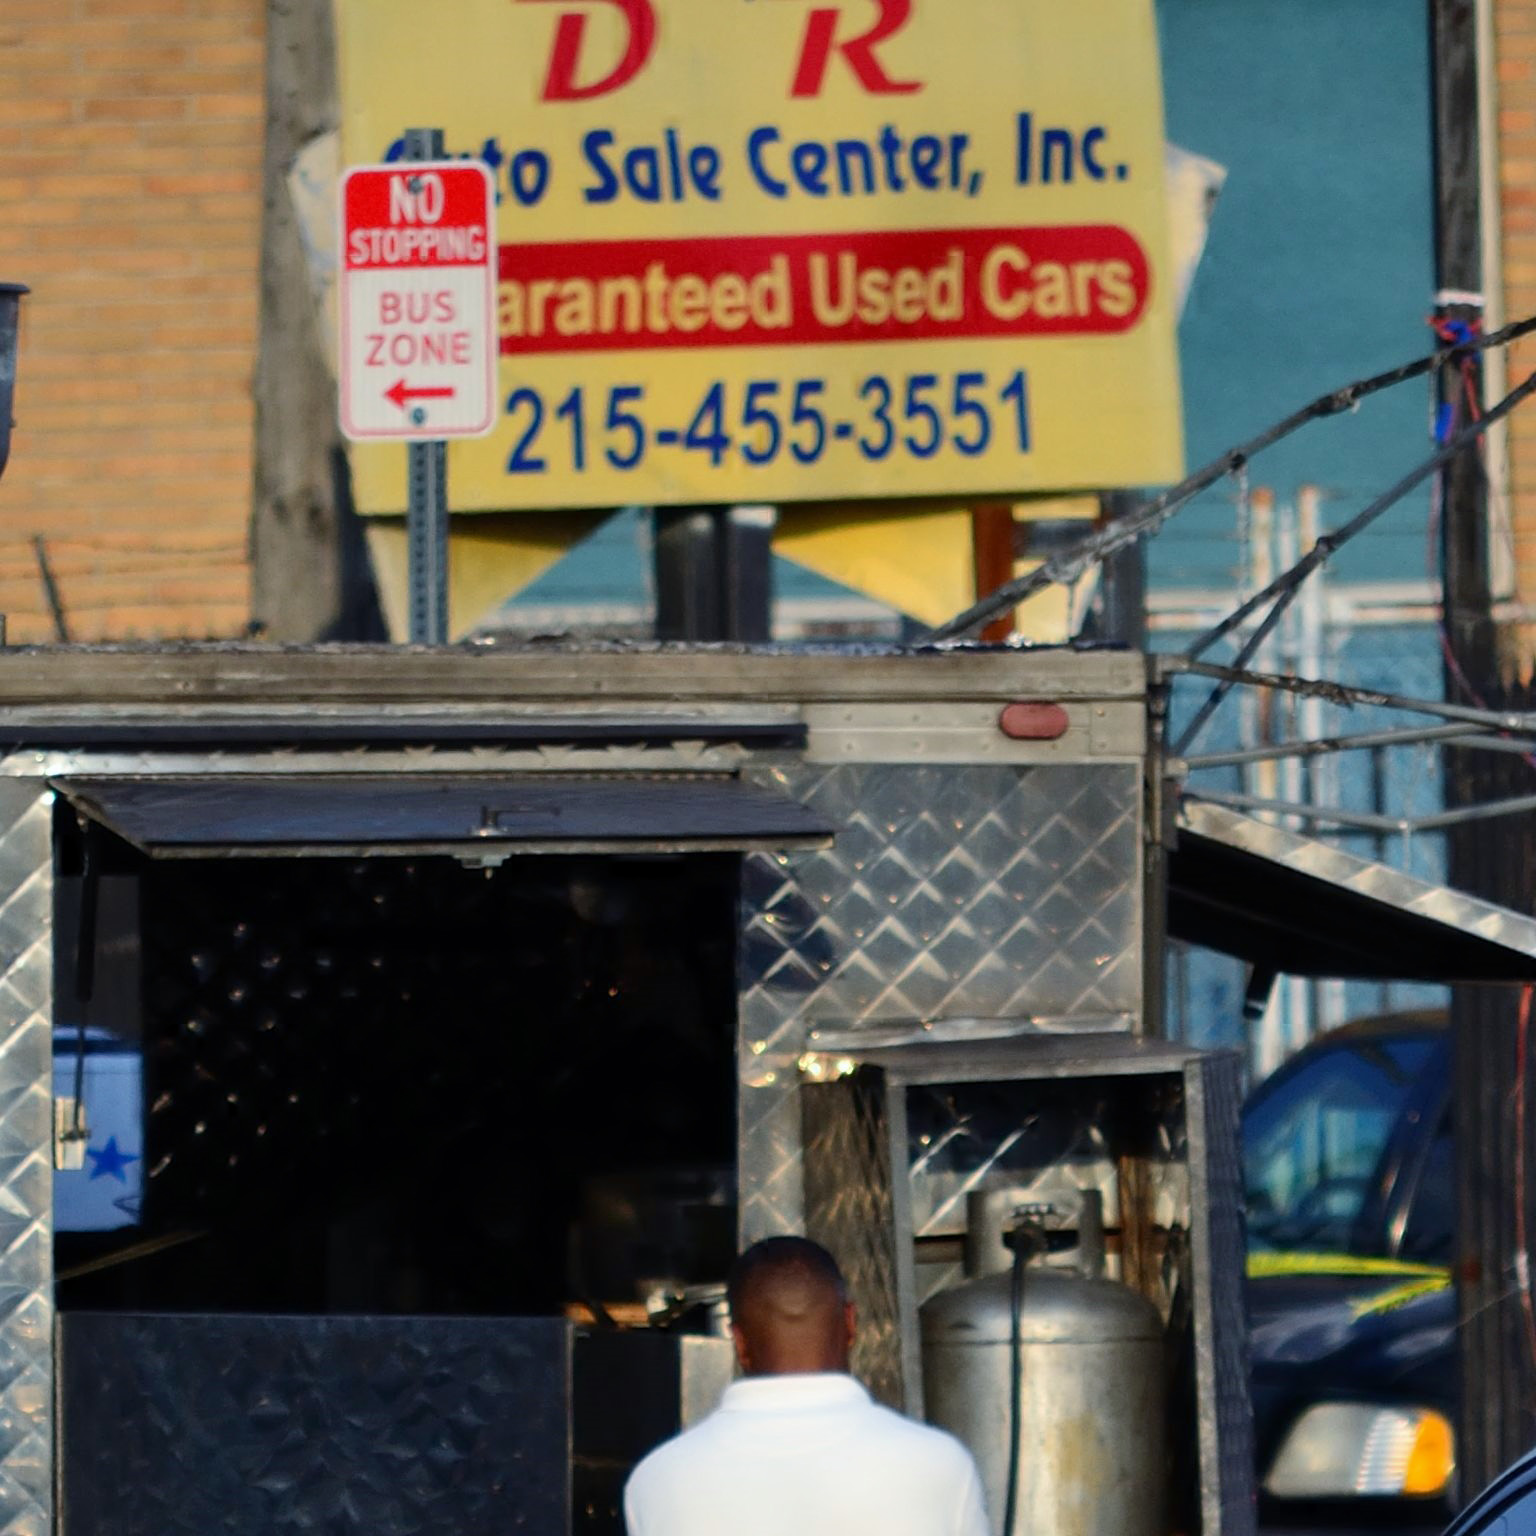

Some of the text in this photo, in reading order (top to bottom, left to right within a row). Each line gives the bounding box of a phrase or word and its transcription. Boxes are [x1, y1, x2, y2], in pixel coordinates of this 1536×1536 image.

[518, 0, 659, 103] D
[582, 128, 722, 204] Sale
[748, 123, 983, 199] Center,
[1016, 111, 1129, 187] Inc.
[388, 172, 446, 225] NO
[349, 225, 486, 265] STOPPING
[379, 291, 456, 325] BUS
[499, 244, 1139, 338] aranteed Used Cars
[365, 331, 471, 367] ZONE
[506, 369, 1035, 475] 215-455-3551
